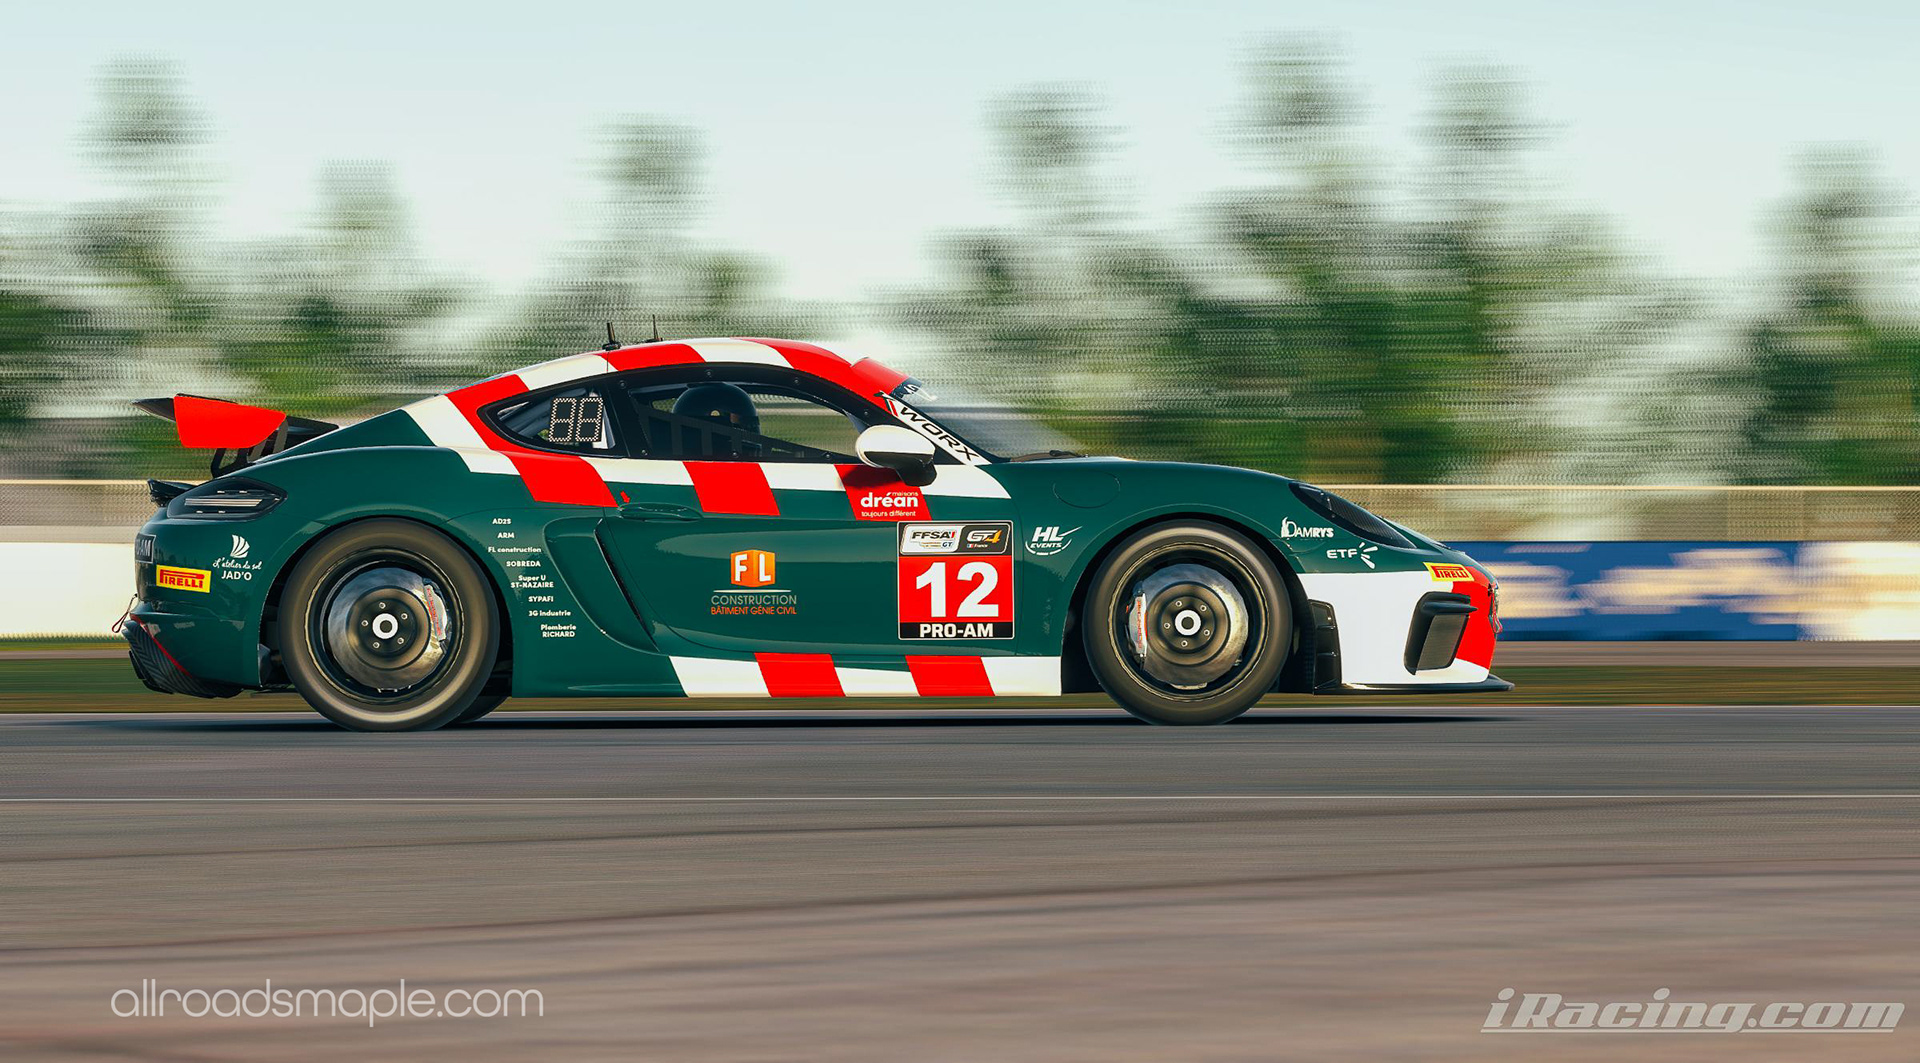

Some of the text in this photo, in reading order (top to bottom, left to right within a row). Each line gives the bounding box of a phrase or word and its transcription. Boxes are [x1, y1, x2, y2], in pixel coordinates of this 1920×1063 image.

[900, 407, 980, 461] WORX
[860, 491, 919, 508] dréan
[911, 531, 951, 540] FFSA
[966, 530, 1003, 544] GT4
[1032, 526, 1064, 542] HL
[1326, 548, 1358, 559] ETF
[734, 553, 772, 582] FL
[1431, 566, 1470, 579] PIRELLI
[160, 569, 205, 589] PIRELLI
[221, 570, 252, 581] JAD'O
[518, 575, 539, 583] Super
[915, 561, 999, 618] 12
[711, 594, 797, 605] CONSTRUCTION
[750, 605, 775, 615] GÉNIE
[776, 606, 797, 615] CIVIL
[919, 623, 994, 638] PRO-AM
